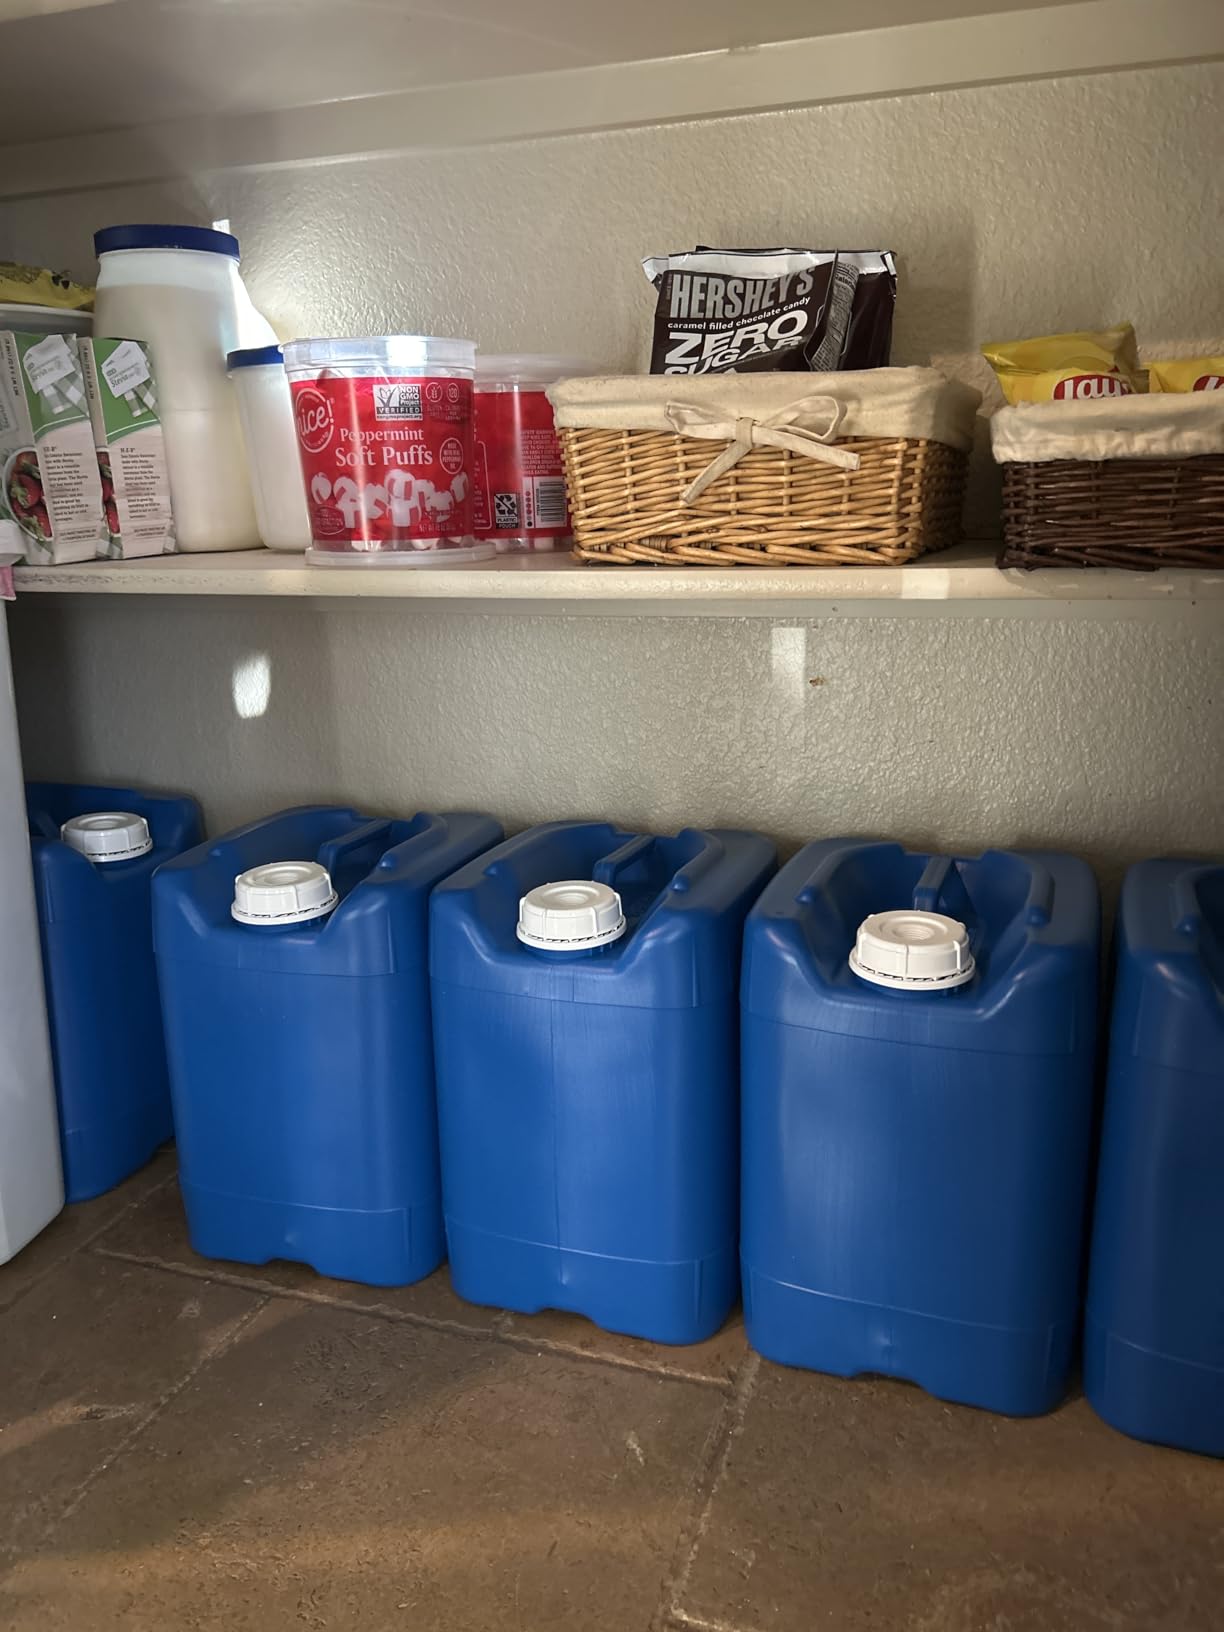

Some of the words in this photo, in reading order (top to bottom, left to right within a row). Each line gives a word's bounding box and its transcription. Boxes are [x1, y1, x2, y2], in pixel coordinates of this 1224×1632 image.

[669, 267, 815, 319] HERSHEY'S
[667, 321, 707, 330] caramel
[709, 320, 734, 330] filled
[736, 307, 781, 327] chocolate
[783, 296, 811, 312] candy
[664, 309, 809, 365] ZERO
[340, 426, 424, 445] Peppermint
[335, 445, 376, 467] Soft
[381, 444, 434, 466] Puffs
